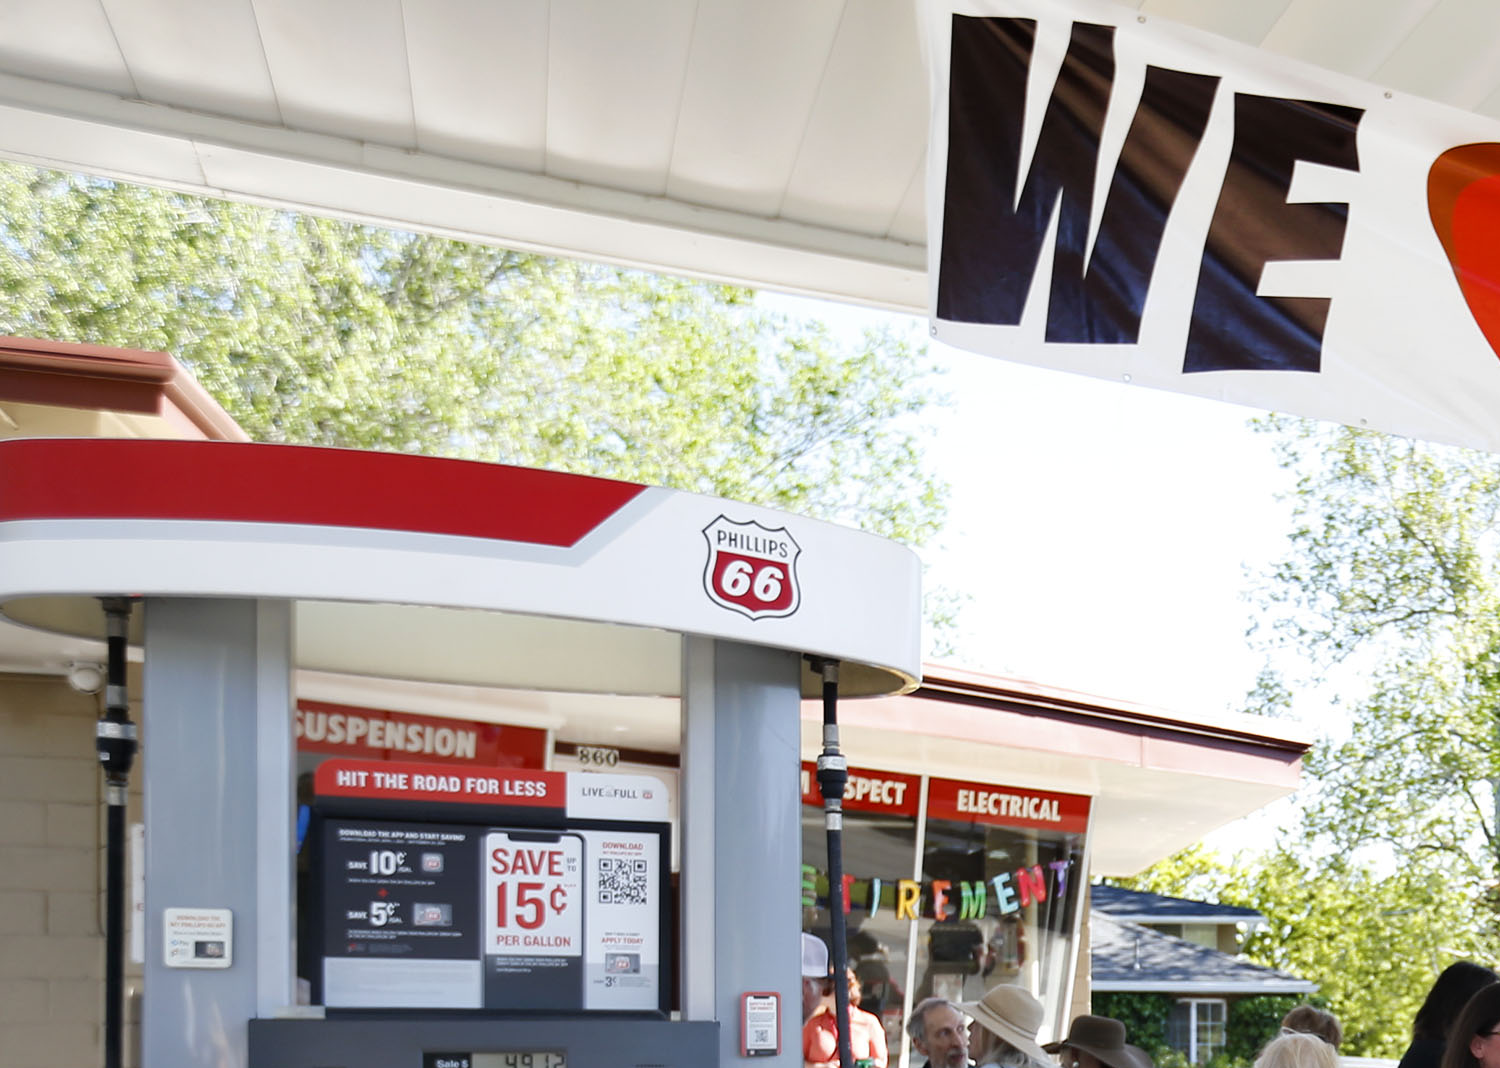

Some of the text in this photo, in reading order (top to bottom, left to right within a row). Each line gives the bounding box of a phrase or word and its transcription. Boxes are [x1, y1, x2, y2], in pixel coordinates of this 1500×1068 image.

[936, 12, 1367, 374] WE
[717, 529, 788, 558] PHILLIPS
[721, 559, 785, 603] 66
[579, 747, 618, 768] 860
[336, 770, 547, 798] HIT THE ROAD FOR LESS
[581, 787, 604, 798] LIVE
[613, 788, 638, 799] FULL
[842, 774, 907, 806] SPECT
[957, 788, 1062, 822] ELECTRICAL
[378, 830, 391, 838] THE
[391, 831, 405, 839] APP
[405, 832, 419, 840] AND
[602, 841, 644, 850] DOWNLOAD
[347, 861, 369, 870] SAVE
[492, 848, 564, 877] SAVE
[347, 910, 369, 920] SAVE
[496, 881, 568, 930] 15¢
[496, 934, 571, 948] PER GALLON
[436, 1059, 469, 1068] Sale $
